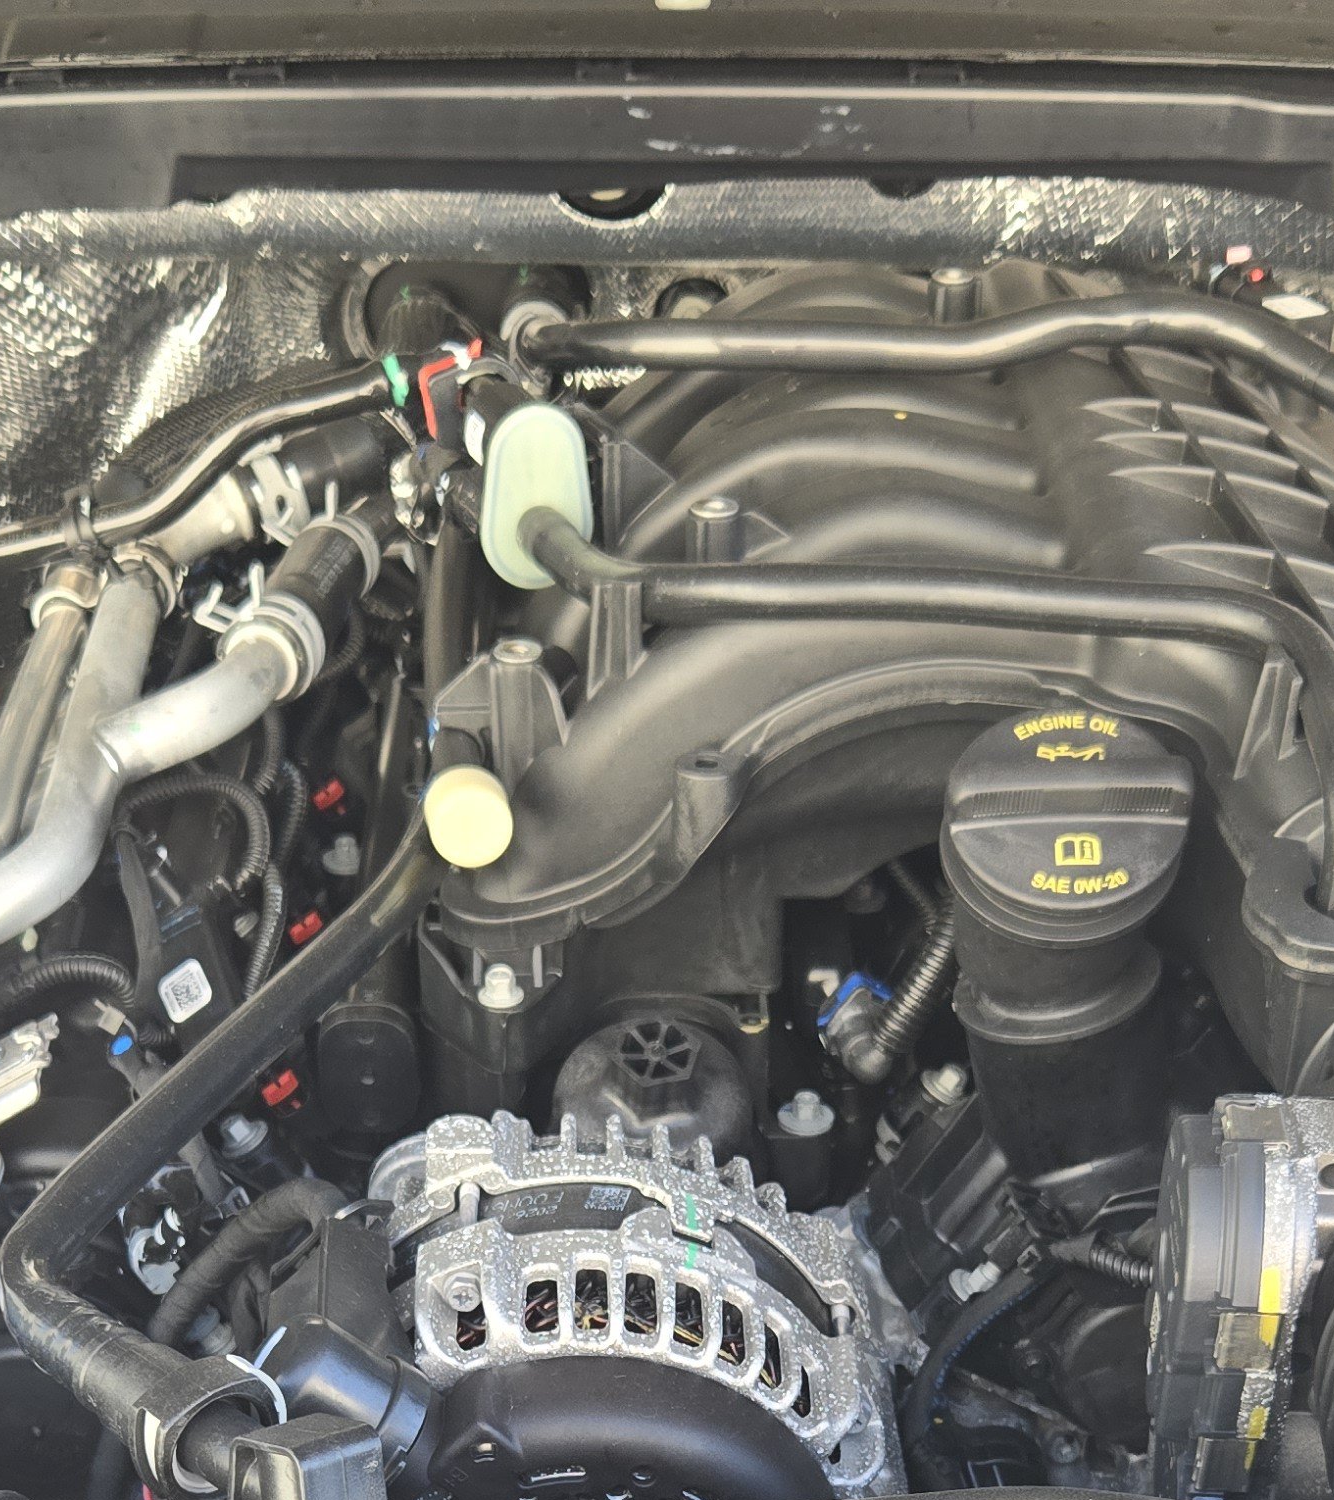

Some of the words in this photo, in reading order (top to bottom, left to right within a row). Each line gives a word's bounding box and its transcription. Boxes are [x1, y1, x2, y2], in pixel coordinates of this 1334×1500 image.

[1014, 714, 1087, 741] ENGINE
[1089, 716, 1120, 738] OIL
[1031, 870, 1070, 894] SAE
[1073, 867, 1129, 894] 0W-20
